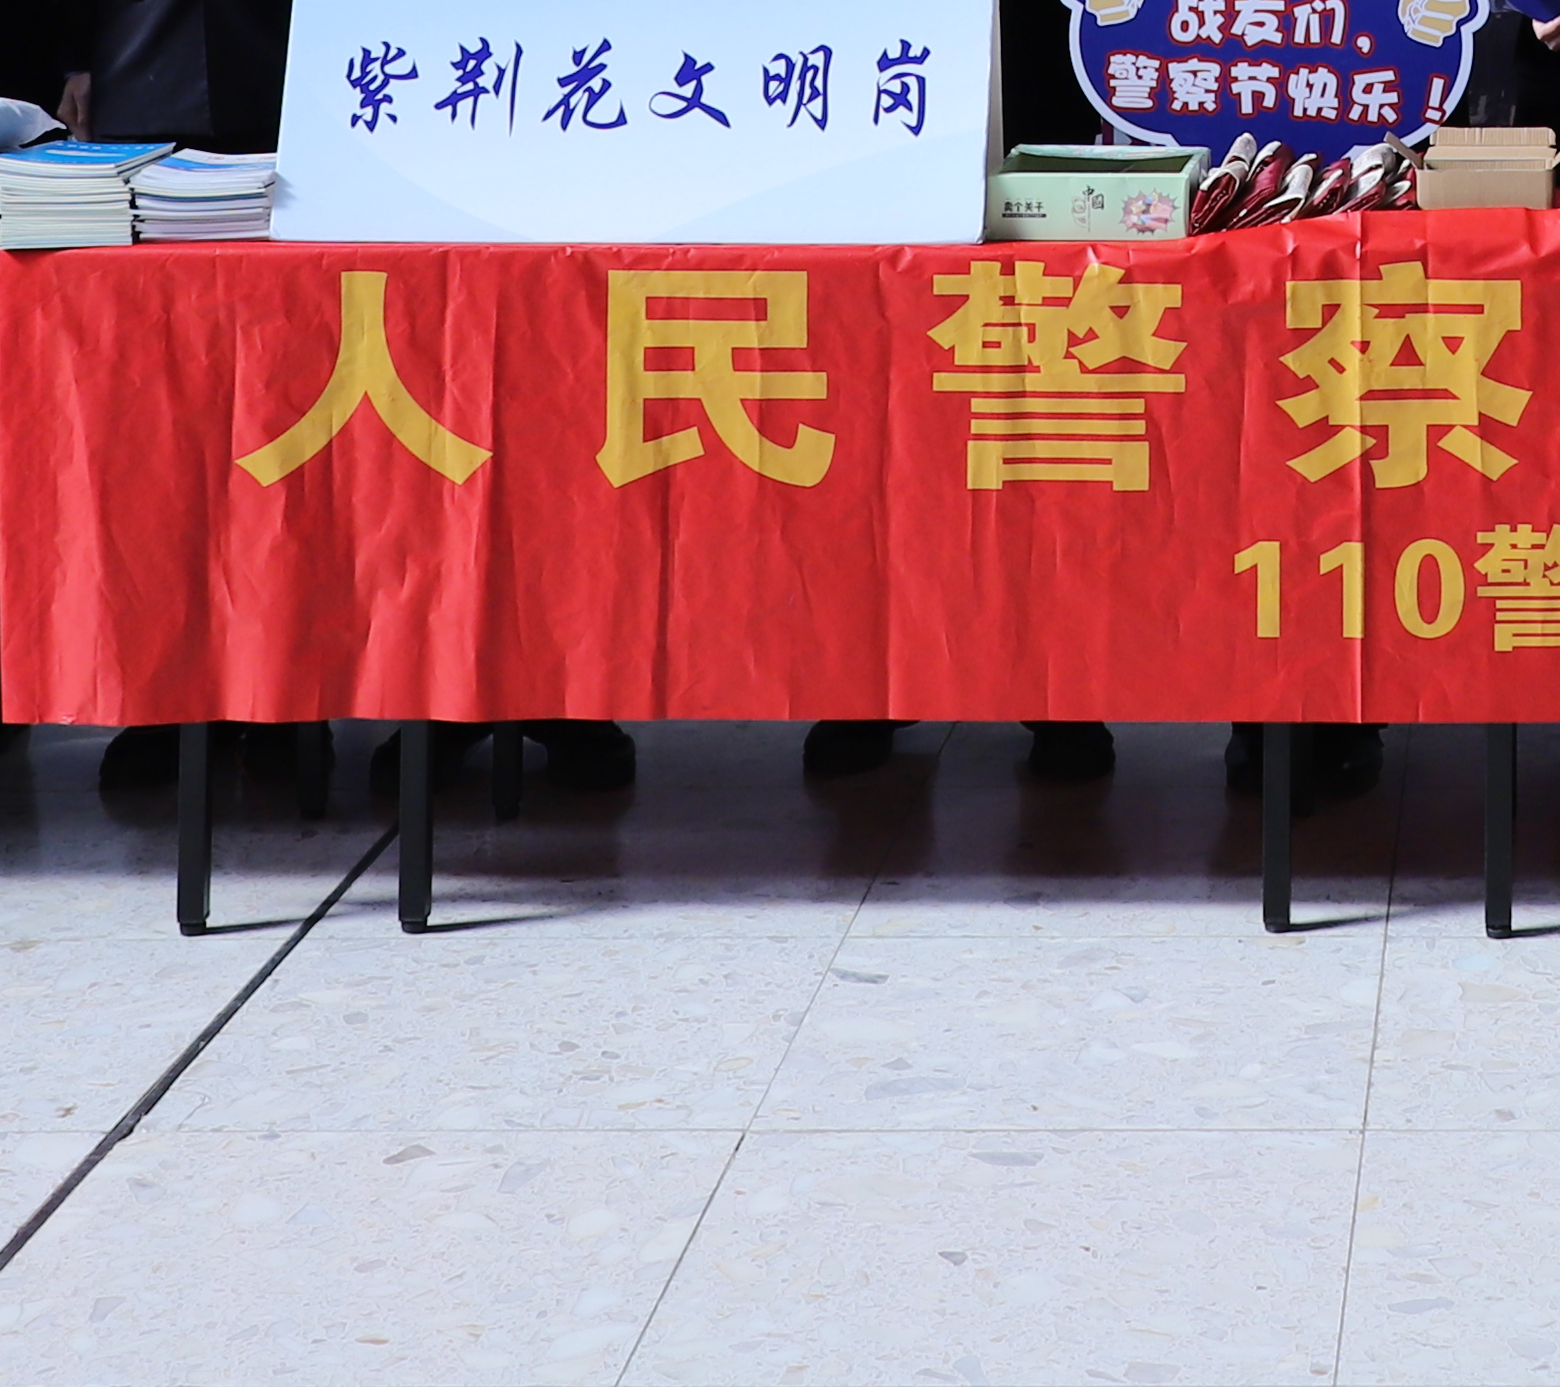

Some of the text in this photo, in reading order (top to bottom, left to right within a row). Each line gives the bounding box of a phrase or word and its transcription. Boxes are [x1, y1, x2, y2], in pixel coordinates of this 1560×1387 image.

[344, 36, 933, 138] 紫荆花文明岗
[1106, 52, 1449, 125] 警察节快乐！
